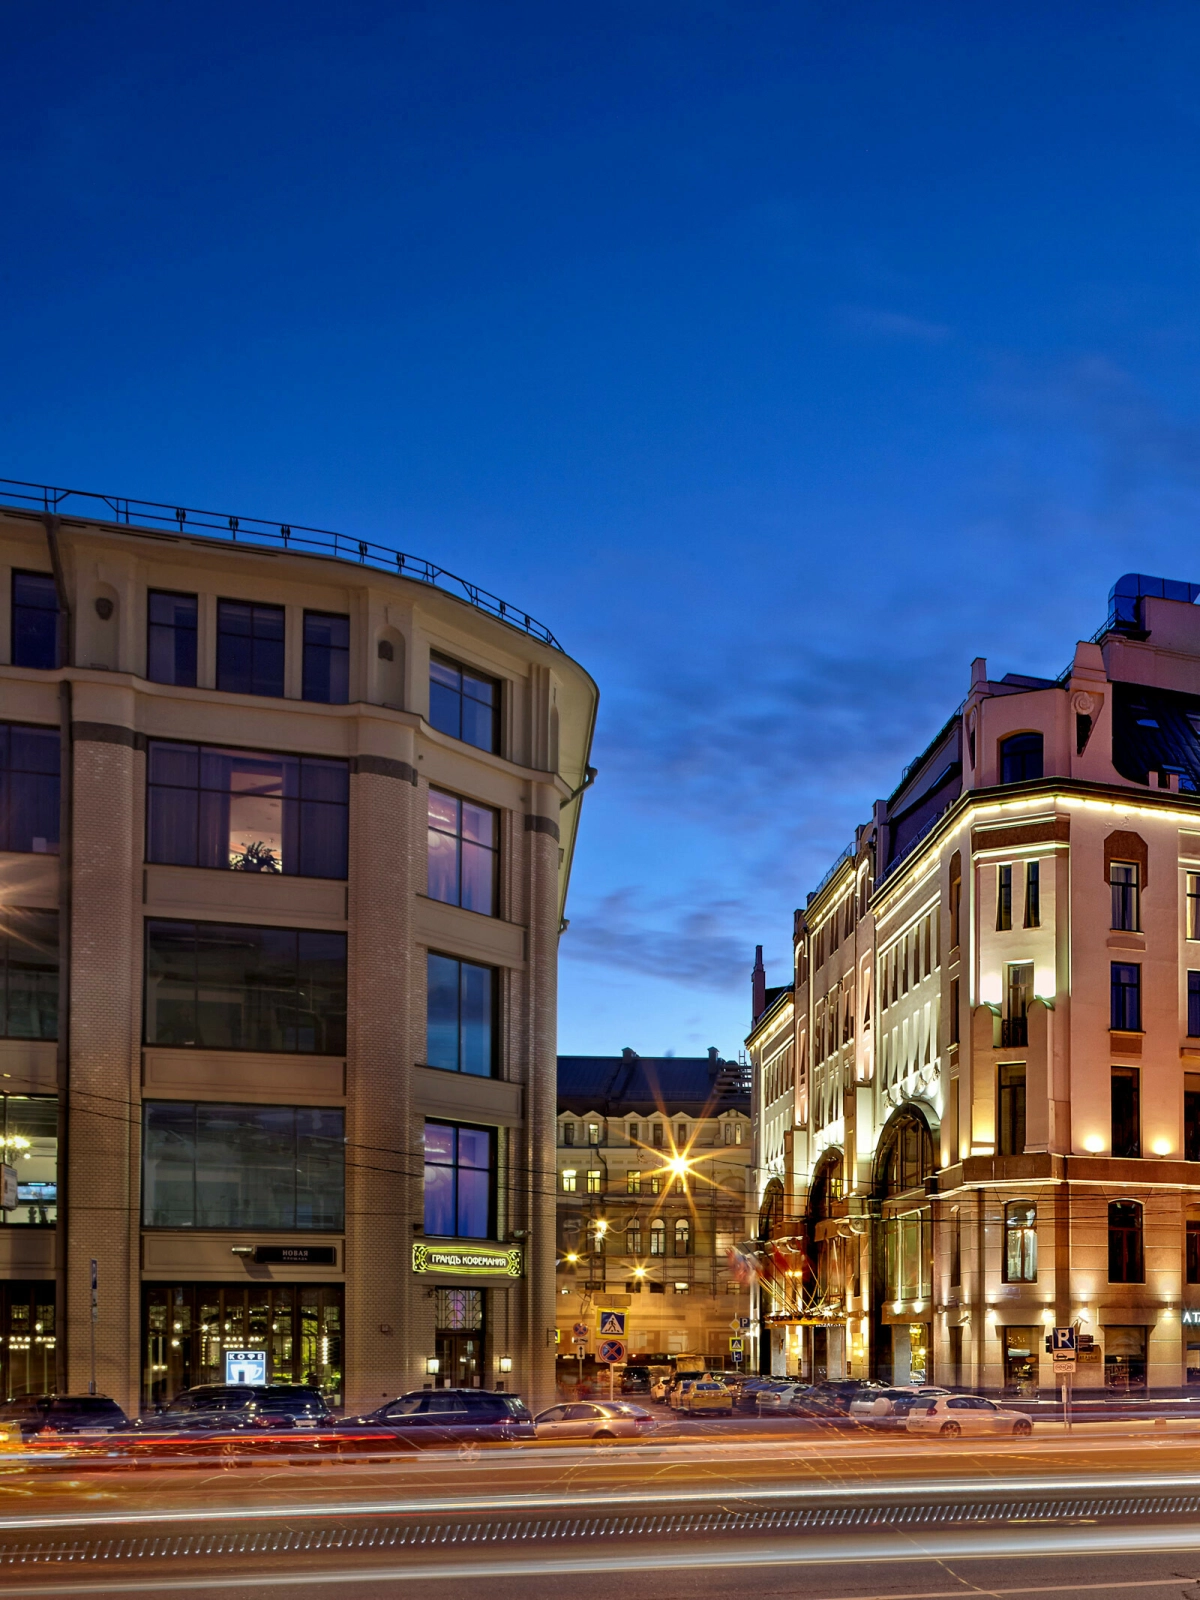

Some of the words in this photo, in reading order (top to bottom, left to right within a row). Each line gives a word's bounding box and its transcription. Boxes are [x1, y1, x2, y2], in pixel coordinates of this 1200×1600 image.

[431, 1254, 461, 1265] ГРАНДЪ
[462, 1256, 507, 1266] КОФЕМАНИЯ
[1183, 1312, 1192, 1323] A
